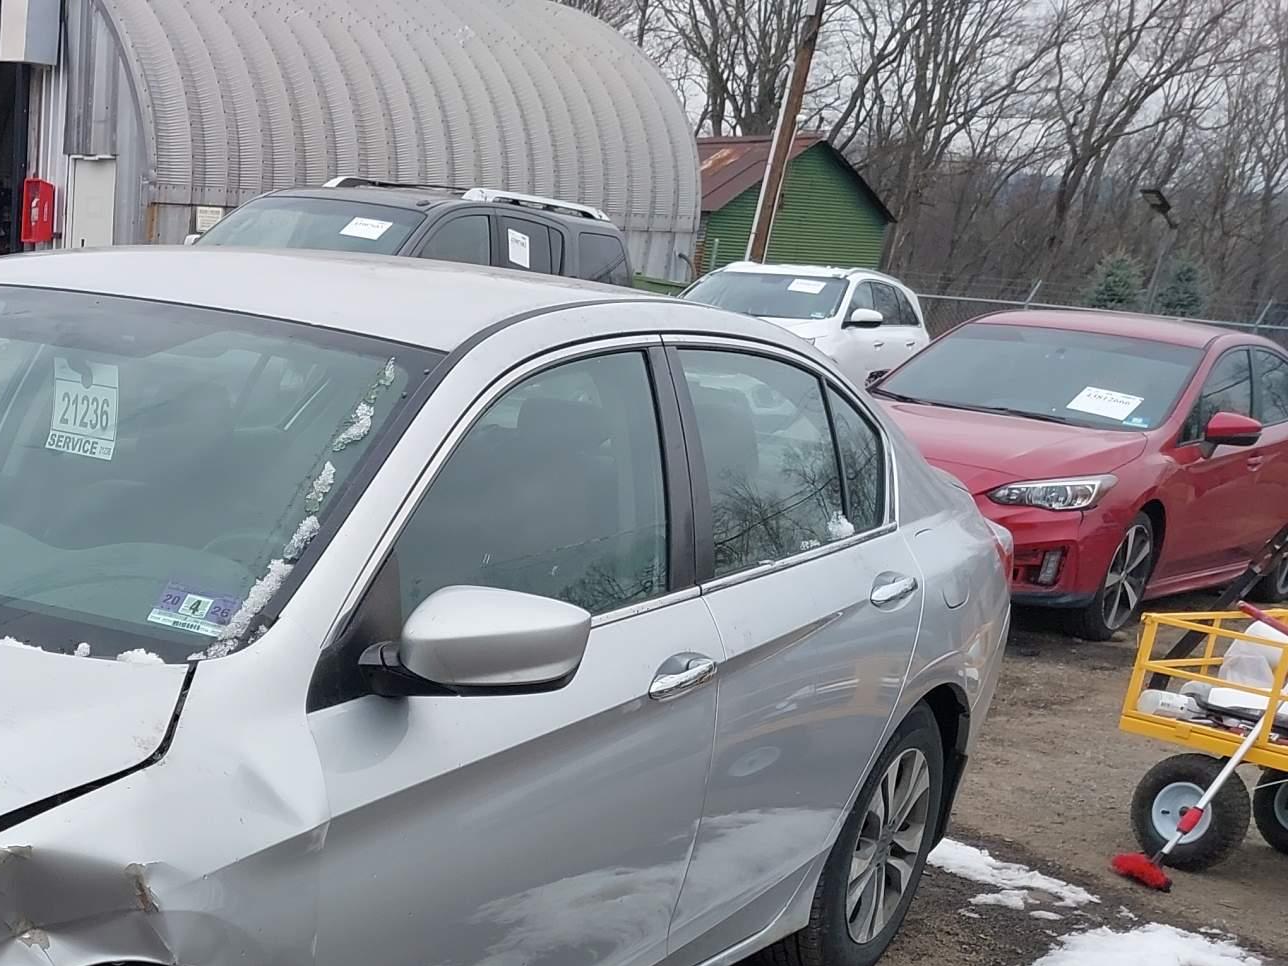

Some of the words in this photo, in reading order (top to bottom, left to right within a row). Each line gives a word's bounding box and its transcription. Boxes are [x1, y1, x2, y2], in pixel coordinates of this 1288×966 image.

[58, 391, 111, 432] 21236
[47, 432, 99, 456] SERVICE
[162, 593, 182, 606] 20
[188, 599, 203, 615] 4
[209, 605, 231, 618] 26
